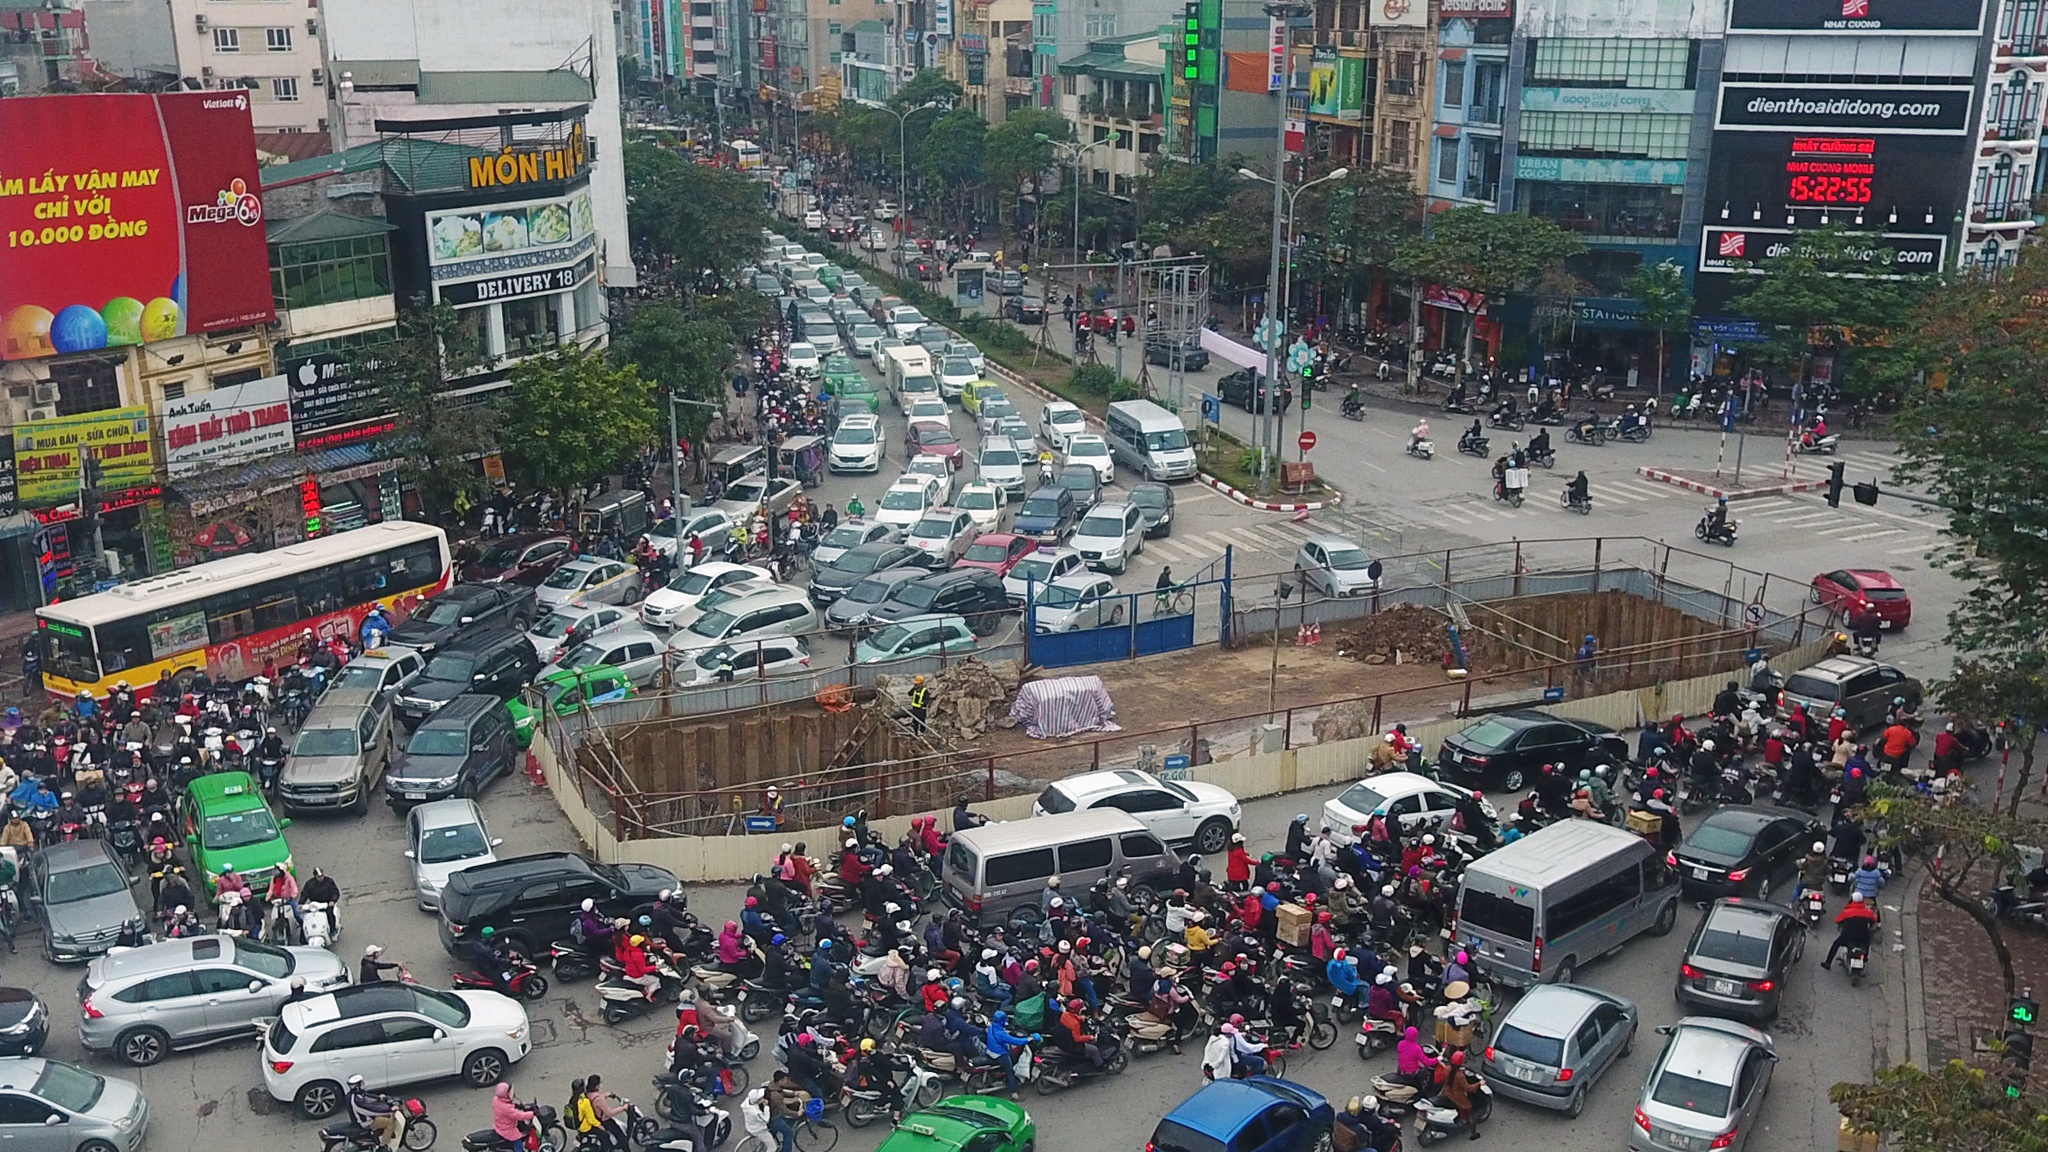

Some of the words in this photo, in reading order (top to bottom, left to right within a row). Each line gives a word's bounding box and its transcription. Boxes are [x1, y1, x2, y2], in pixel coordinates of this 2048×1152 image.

[1824, 20, 1847, 28] NHAT
[1848, 21, 1881, 29] CUONG
[1562, 96, 1591, 104] GOOD
[1747, 97, 1940, 119] dienthoaididong.com
[469, 145, 538, 188] MÓN
[1519, 158, 1558, 169] URBAN
[28, 168, 69, 194] LẤY
[73, 169, 117, 194] VẬN
[121, 168, 160, 188] MAY
[1790, 176, 1872, 202] 15:22:55
[34, 194, 69, 219] CHỈ
[73, 194, 111, 216] VỚI
[188, 204, 236, 223] Mega
[9, 225, 84, 248] 10.000
[88, 215, 148, 240] ĐỒNG
[477, 273, 552, 300] DELIVERY
[556, 269, 574, 286] 18
[169, 406, 187, 418] Anh
[252, 402, 289, 429] TRANG
[37, 437, 57, 449] MUA
[60, 432, 78, 446] BÁN
[86, 426, 104, 441] SỬA
[106, 424, 130, 438] CHỮA
[1508, 885, 1529, 898] VTV
